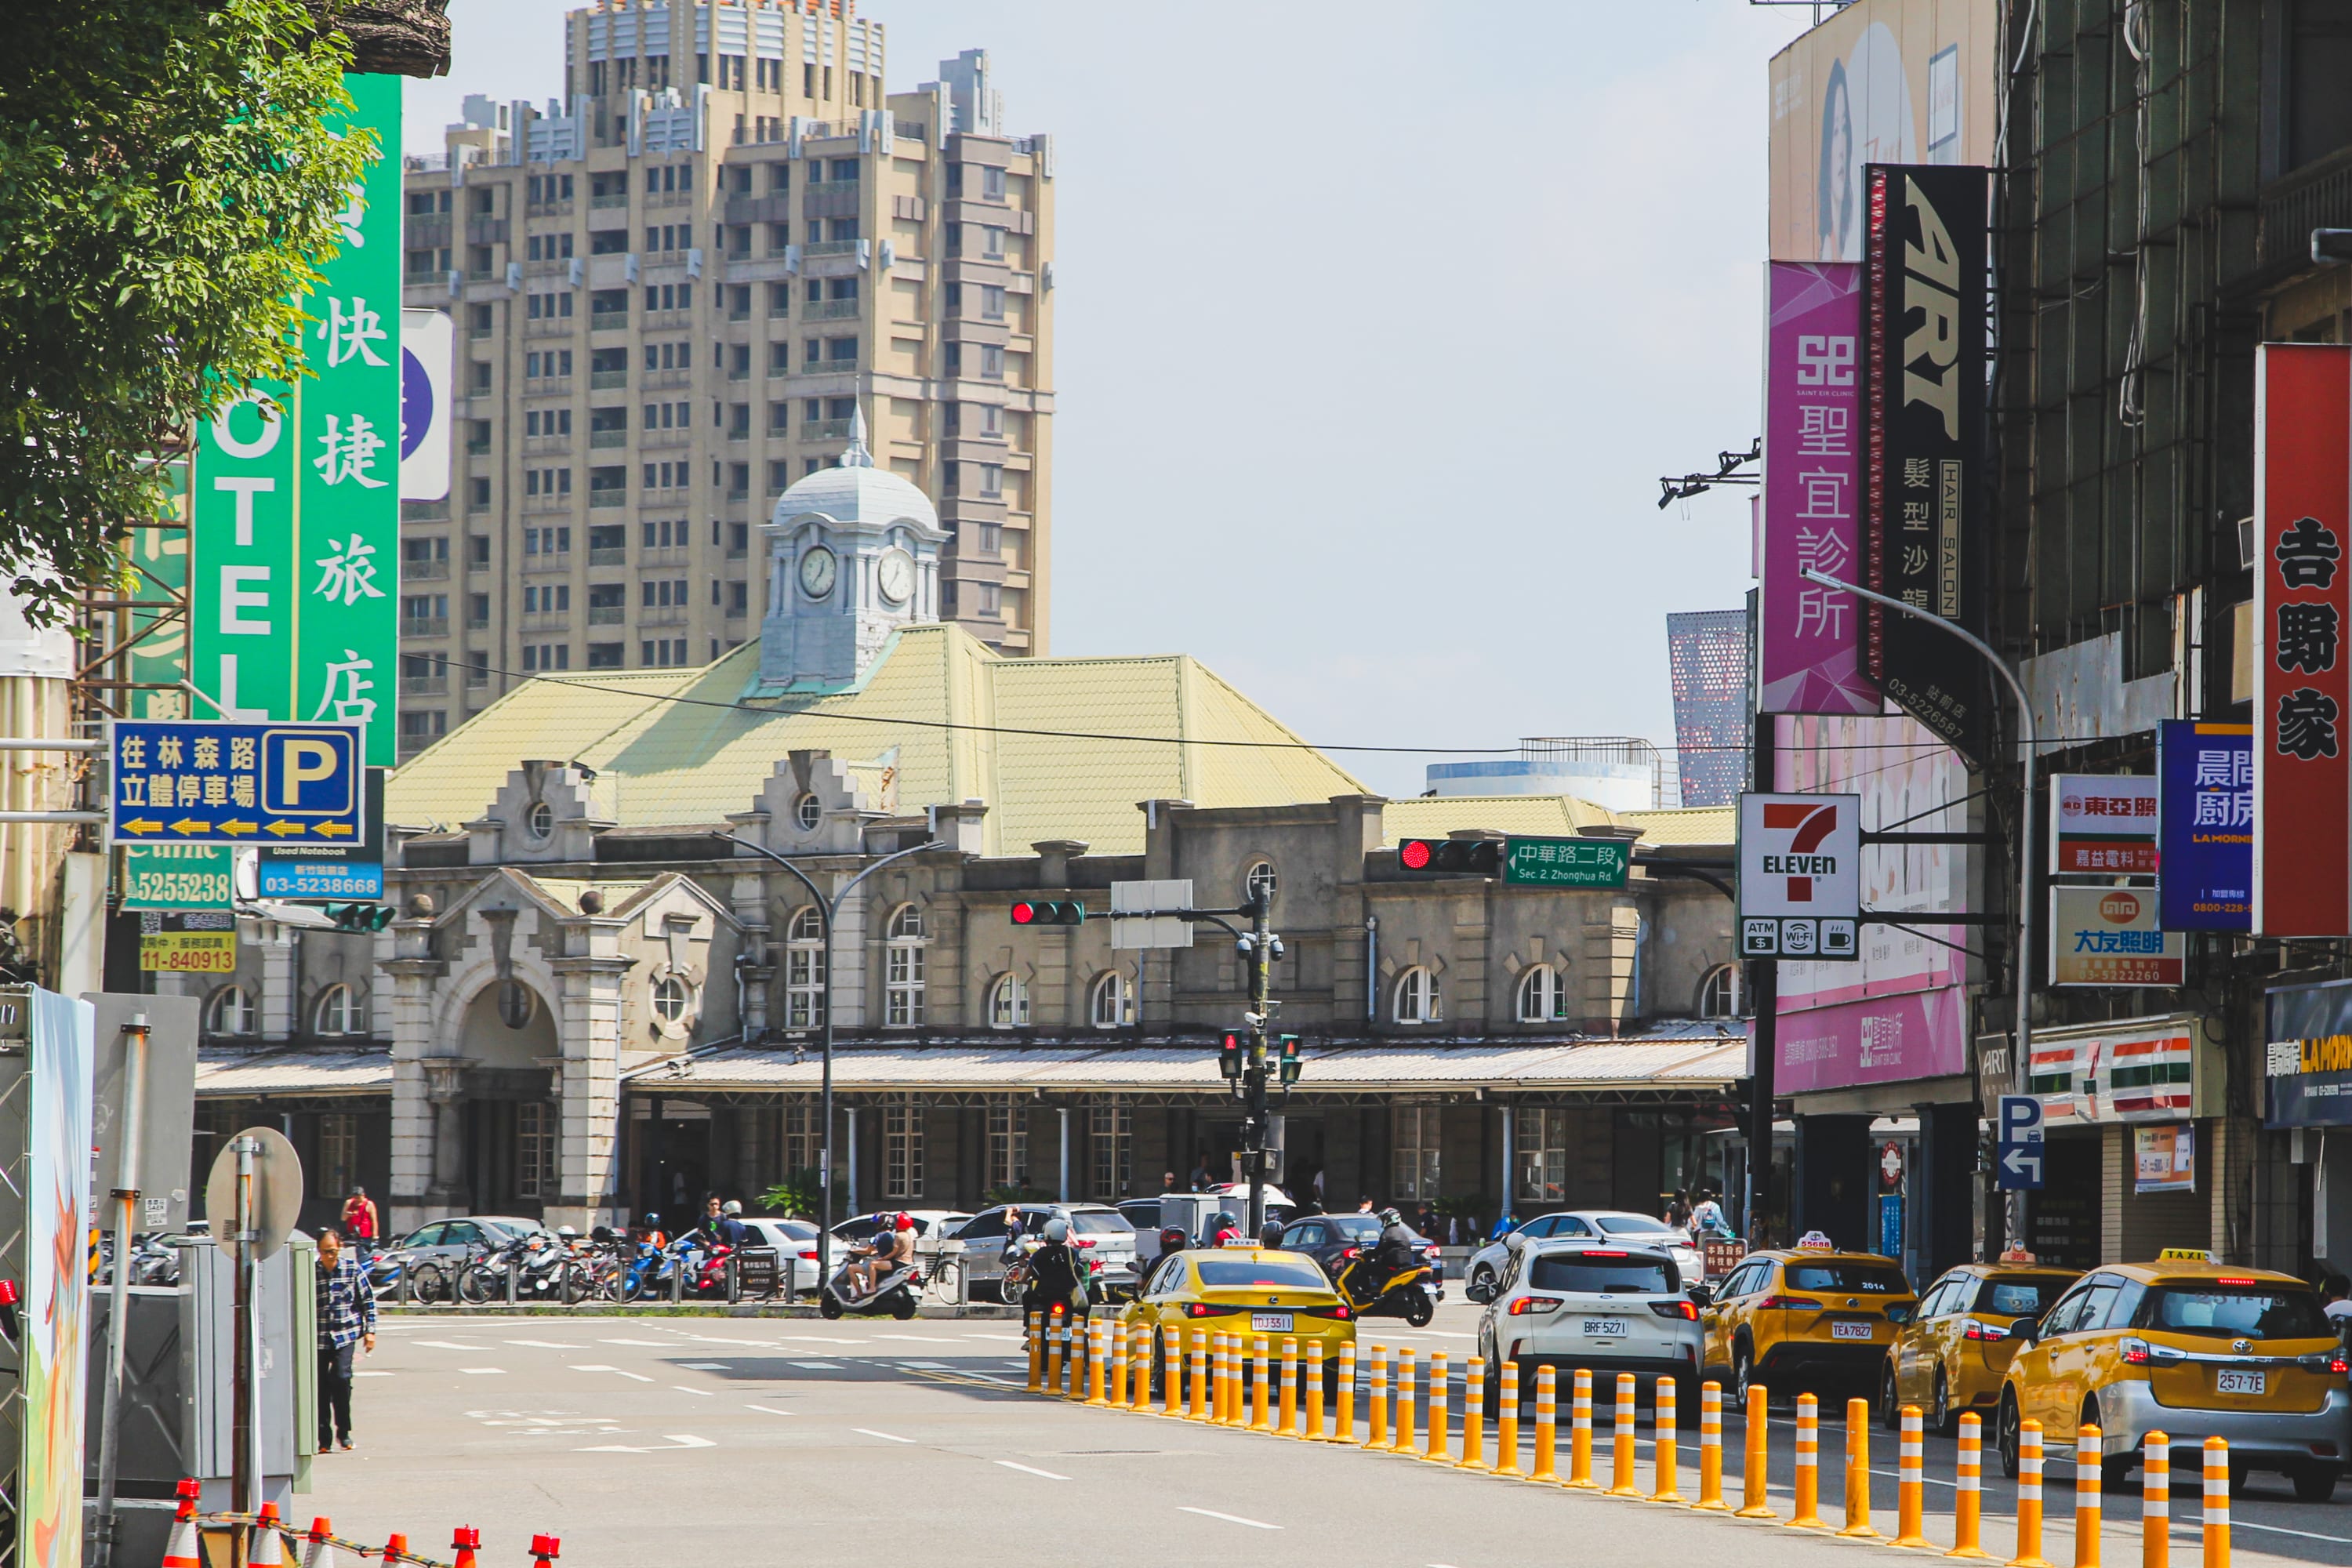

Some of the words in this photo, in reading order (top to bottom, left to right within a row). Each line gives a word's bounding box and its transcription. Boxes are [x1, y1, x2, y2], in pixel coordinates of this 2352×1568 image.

[1904, 173, 1960, 441] ART
[312, 132, 390, 721] 快捷旅店
[1944, 469, 1957, 520] HAIR
[1795, 405, 1851, 639] 聖宜診所
[1903, 458, 1930, 619] 髮型沙龍
[211, 387, 282, 720] OTEL
[1944, 536, 1956, 610] SALON
[2275, 516, 2342, 760] 吉野家
[1889, 678, 1964, 739] 03-5226587
[1926, 684, 1967, 719] 站前店
[120, 736, 256, 771] 往林森路
[283, 739, 337, 805] P
[120, 774, 256, 808] 立體停車場
[2193, 834, 2210, 843] LA
[1519, 844, 1616, 865] 中華路二段
[1764, 804, 1837, 902] 7
[2076, 850, 2134, 868] 嘉益電料
[139, 873, 230, 902] 5255238
[266, 877, 377, 894] 03-5238668
[1519, 869, 1537, 879] Sec.
[1551, 869, 1595, 883] Zhonghua
[1599, 872, 1612, 881] Rd.
[1748, 923, 1774, 933] ATM
[1786, 932, 1813, 942] Wi-Fi
[2074, 930, 2164, 953] 大友照明
[142, 951, 233, 969] 11-840913
[2079, 971, 2159, 981] 03-5222260
[1983, 1048, 2006, 1075] ART
[2002, 1098, 2041, 1142] P
[2167, 1250, 2201, 1261] TAXI
[1862, 1282, 1886, 1290] 2014
[1584, 1322, 1624, 1334] BRF-5271
[1833, 1325, 1871, 1337] TEA-7827
[2220, 1374, 2263, 1391] 257-7E
